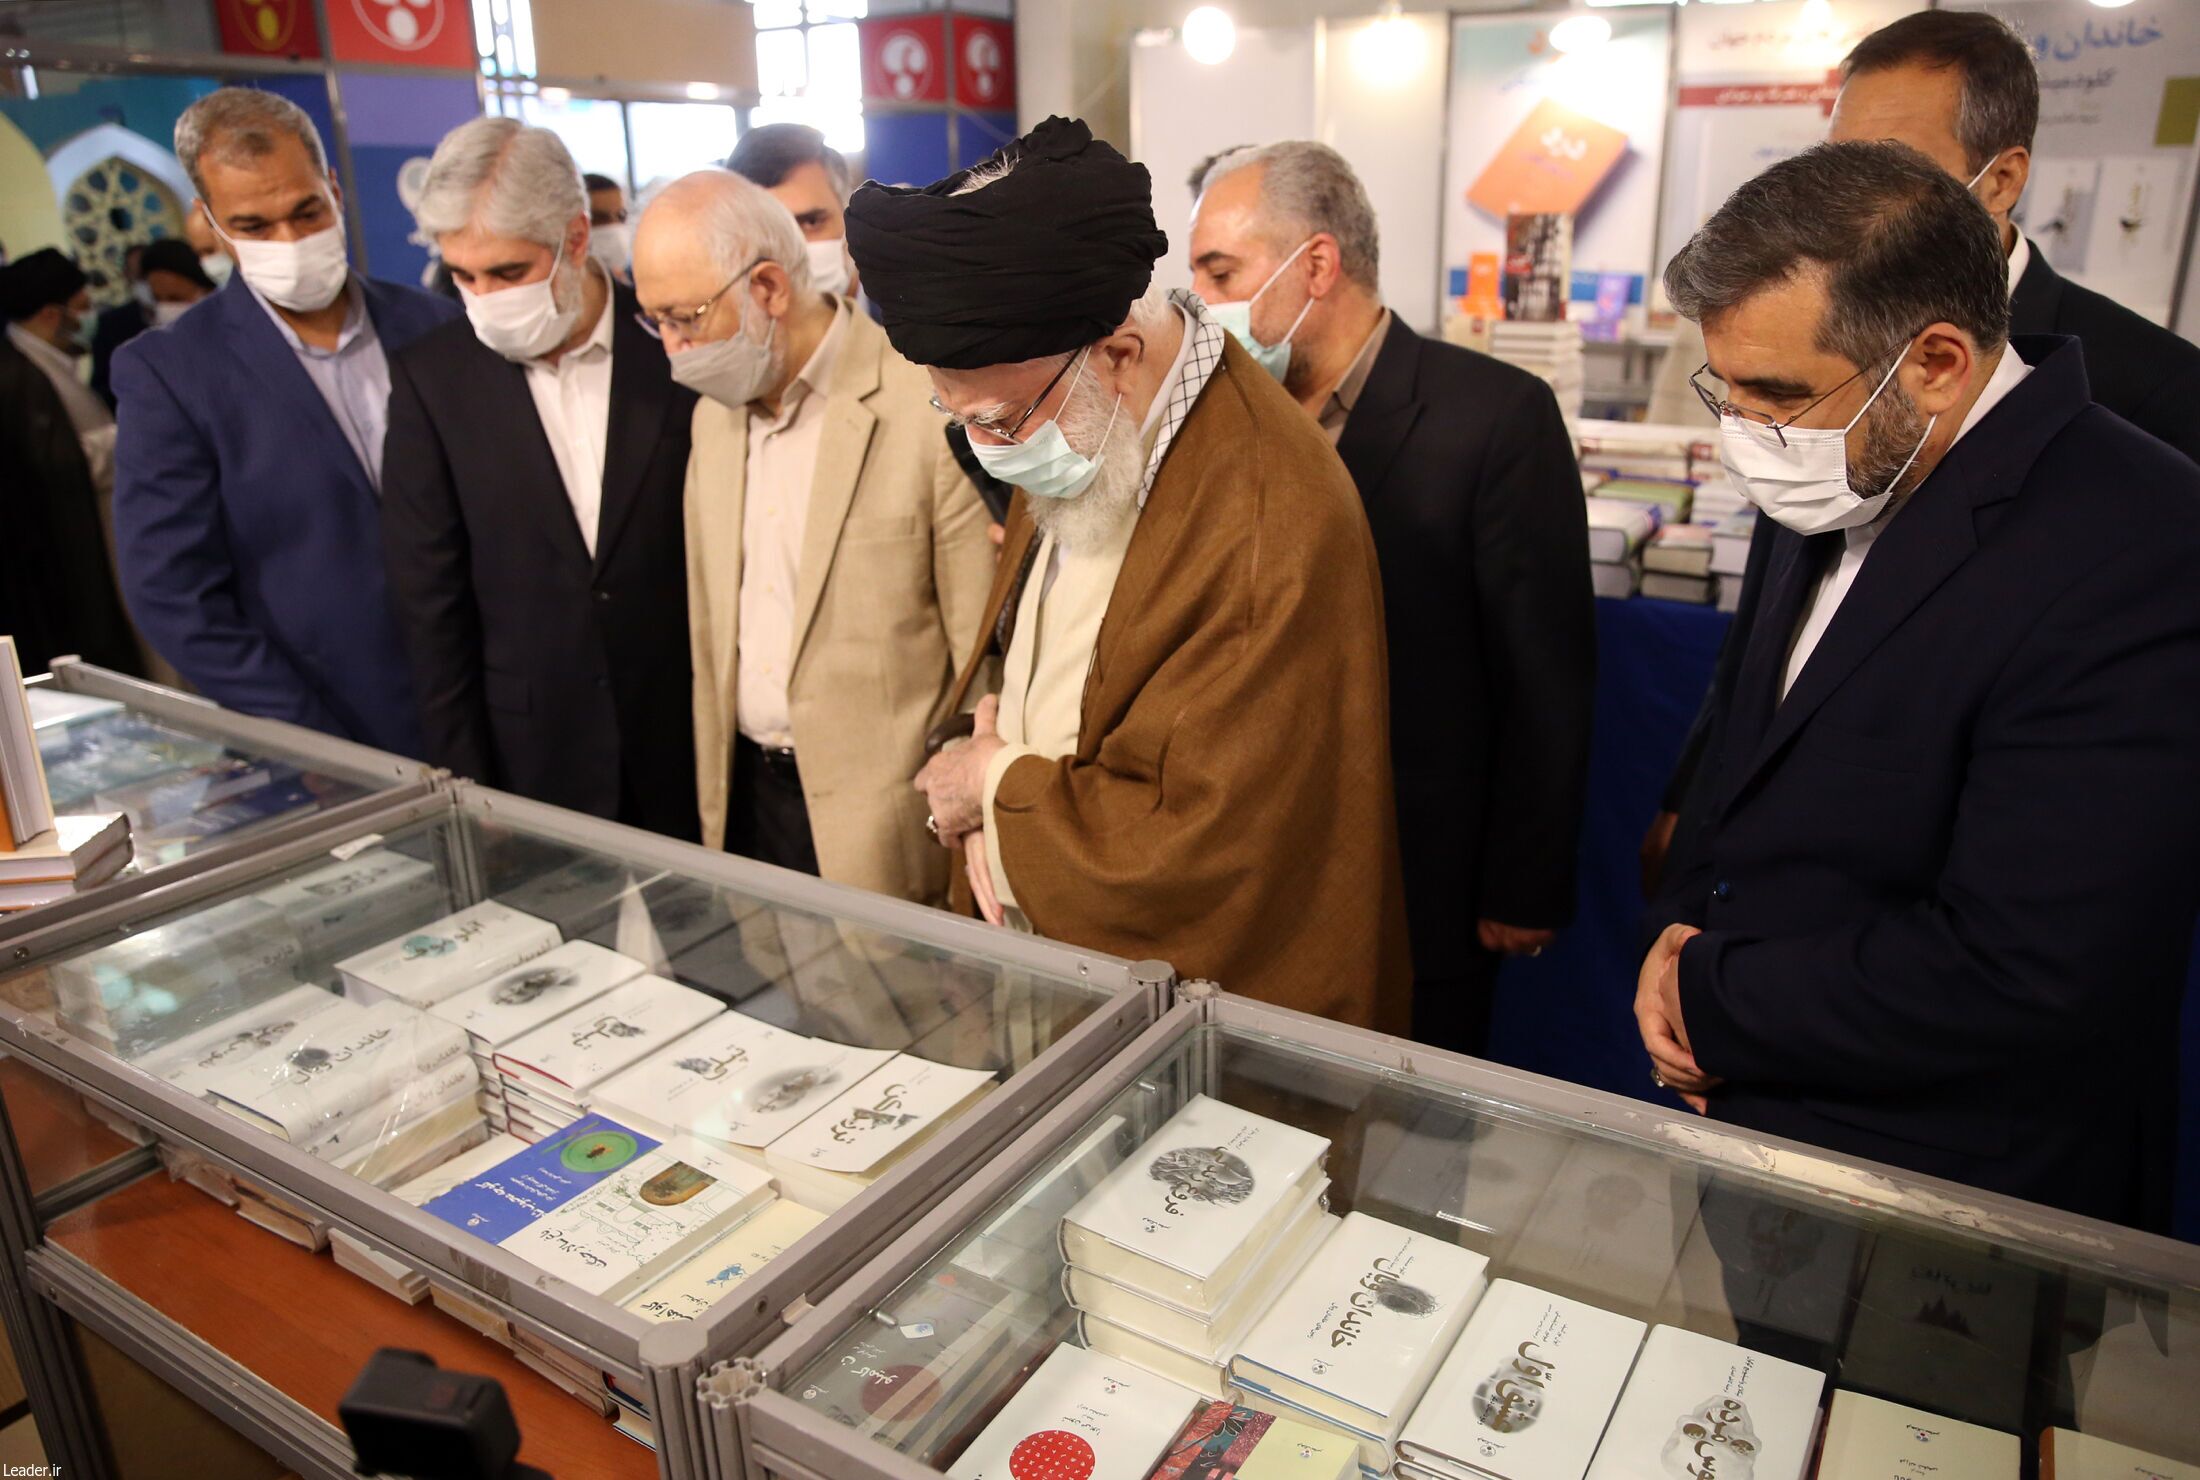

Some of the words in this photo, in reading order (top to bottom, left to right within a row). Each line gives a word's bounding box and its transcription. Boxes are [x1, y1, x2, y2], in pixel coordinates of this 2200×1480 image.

[335, 1029, 391, 1061] خاندان
[541, 1228, 562, 1242] باغ
[1331, 1291, 1374, 1348] خاندان
[1359, 1257, 1401, 1292] ویال
[851, 1366, 899, 1385] کامیلو
[1491, 1379, 1536, 1434] عشق
